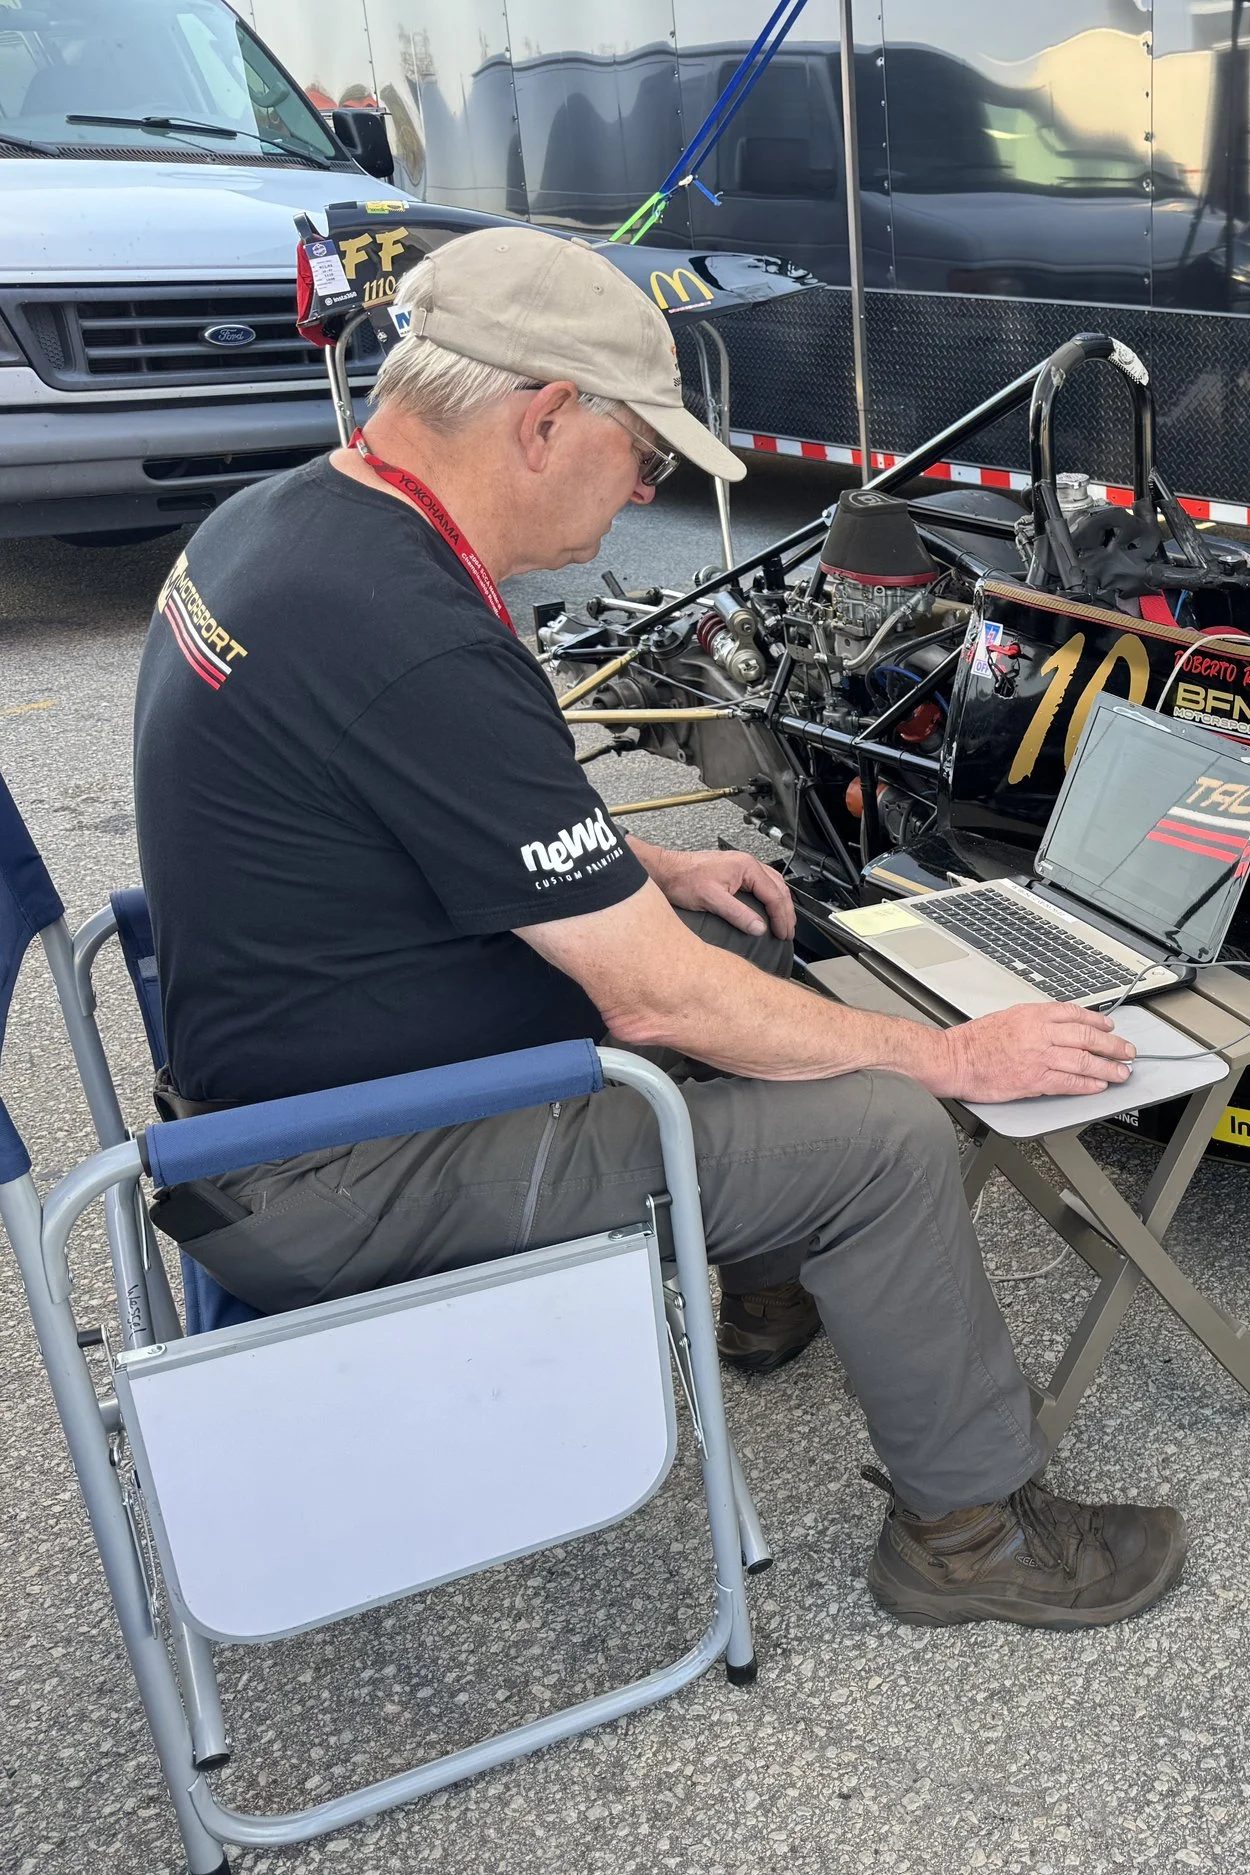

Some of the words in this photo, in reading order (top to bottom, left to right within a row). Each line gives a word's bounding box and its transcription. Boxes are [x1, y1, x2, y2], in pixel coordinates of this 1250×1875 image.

[339, 226, 409, 280] FF
[363, 275, 398, 303] 1110
[218, 328, 245, 341] Ford
[399, 472, 460, 546] YOKOHAMA
[176, 571, 249, 662] MOTORSPORT
[535, 870, 583, 890] CUSTOM
